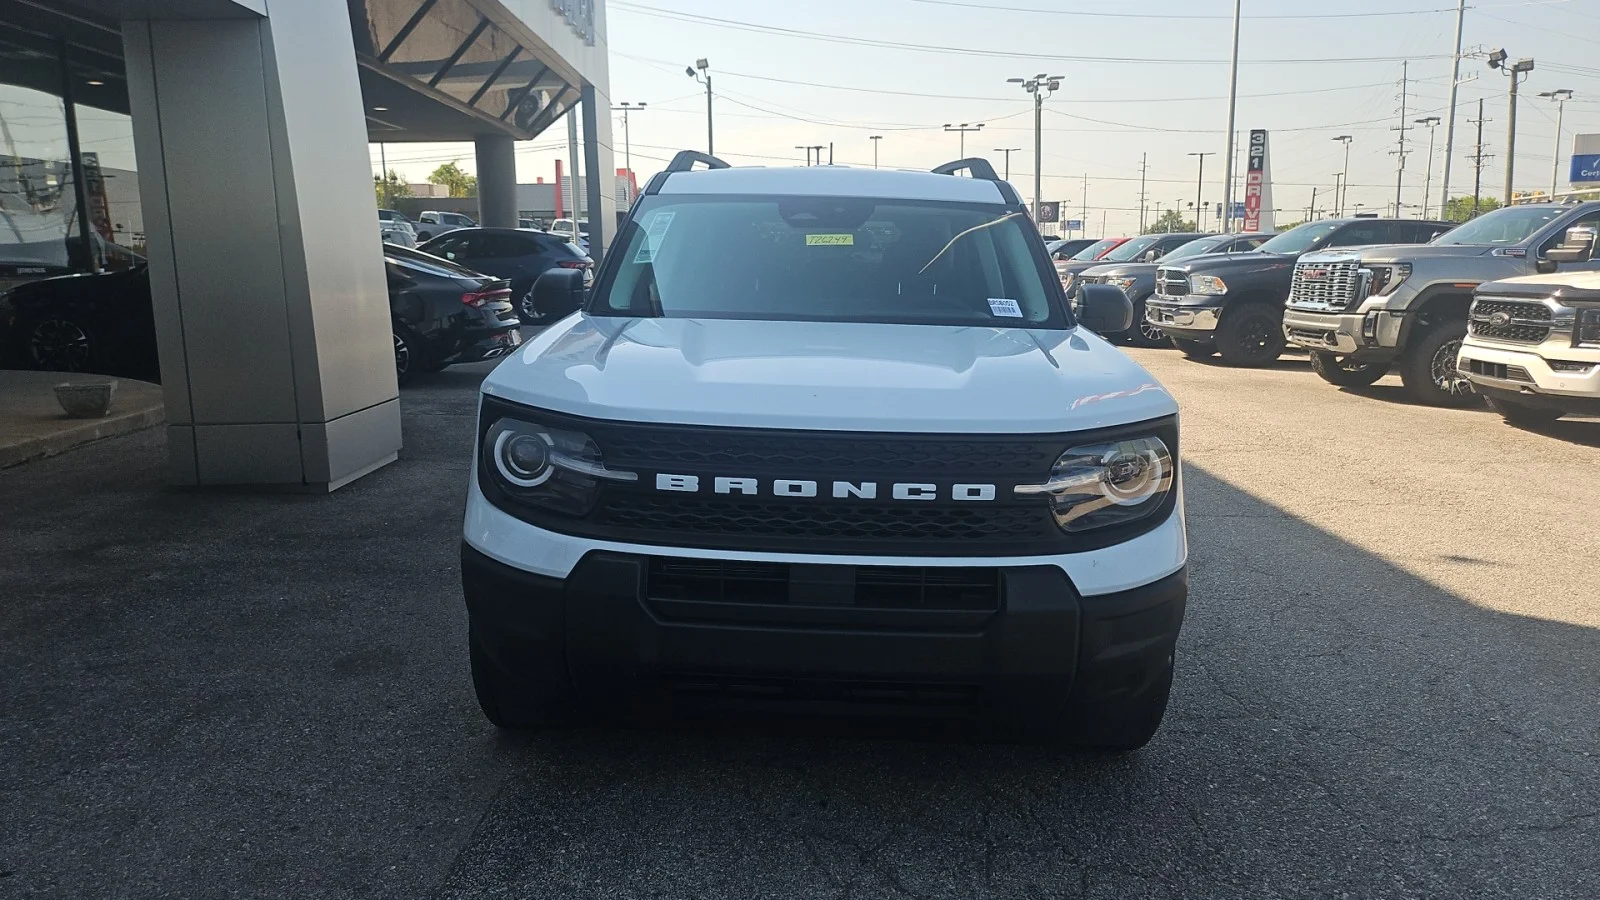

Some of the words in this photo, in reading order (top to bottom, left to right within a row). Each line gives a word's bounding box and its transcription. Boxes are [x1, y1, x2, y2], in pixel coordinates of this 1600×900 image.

[1251, 133, 1264, 168] 321
[1245, 173, 1263, 230] DRIVE
[656, 473, 996, 501] BRONCO
